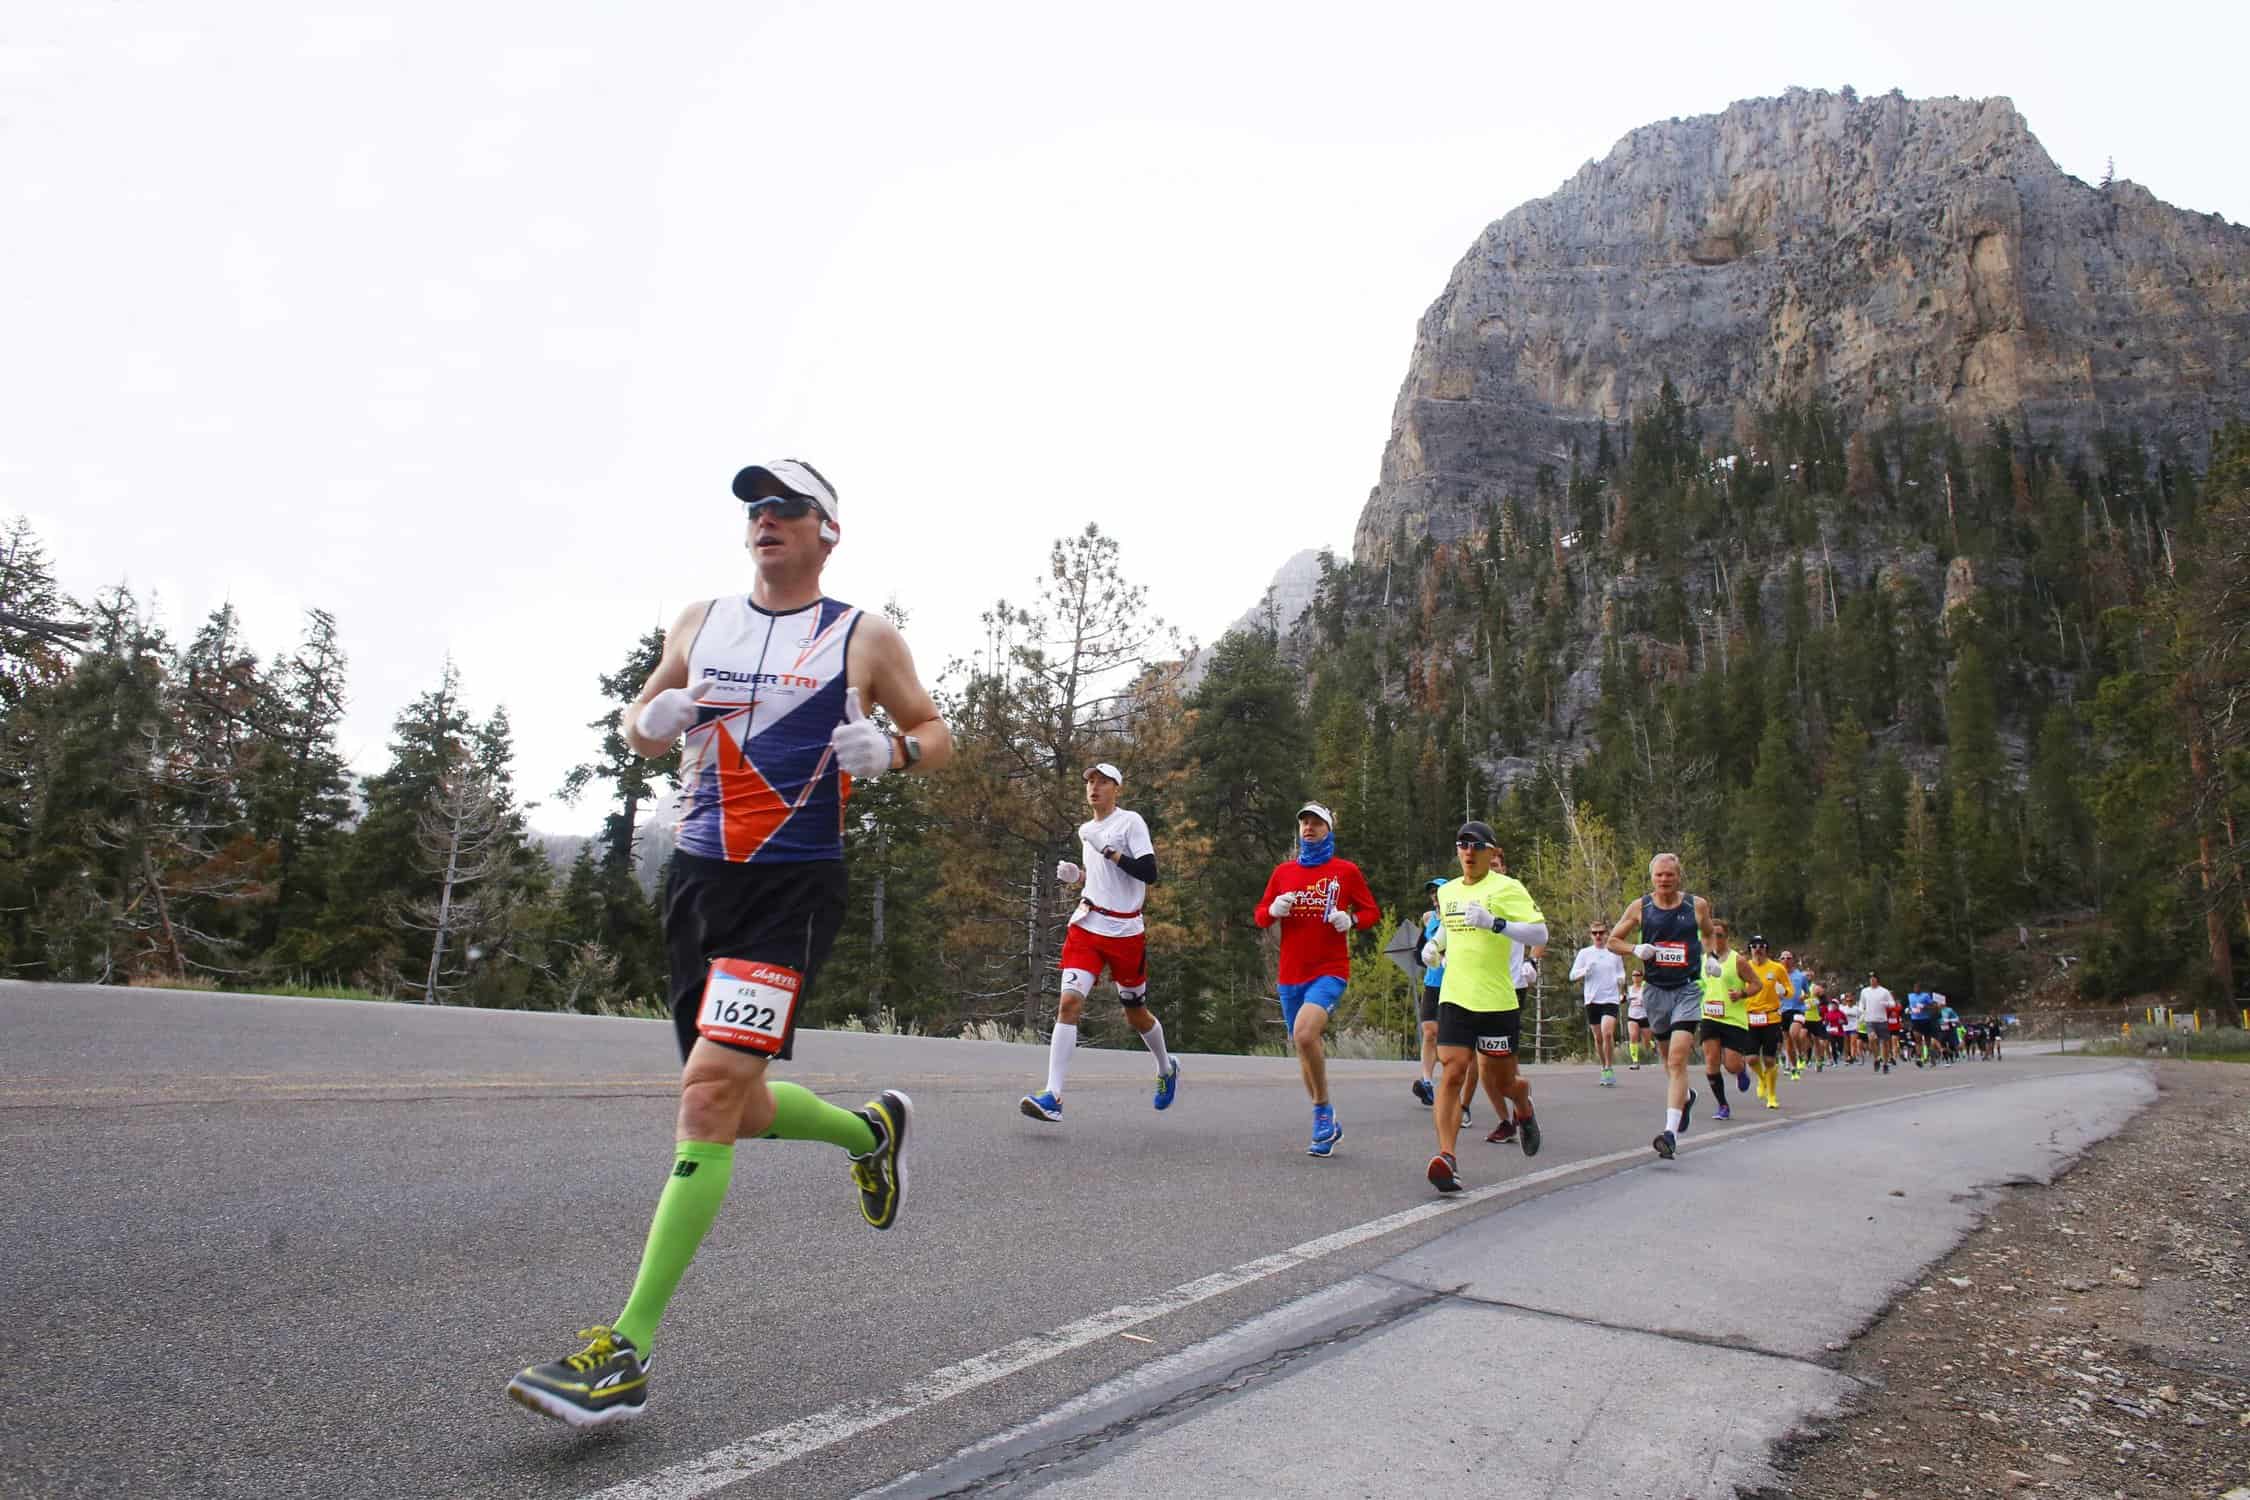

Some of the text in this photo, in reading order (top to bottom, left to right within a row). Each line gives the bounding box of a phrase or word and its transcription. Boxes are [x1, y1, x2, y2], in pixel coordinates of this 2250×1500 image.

[1660, 953, 1681, 961] 1498
[714, 1000, 775, 1031] 1622
[1482, 1039, 1507, 1049] 1678
